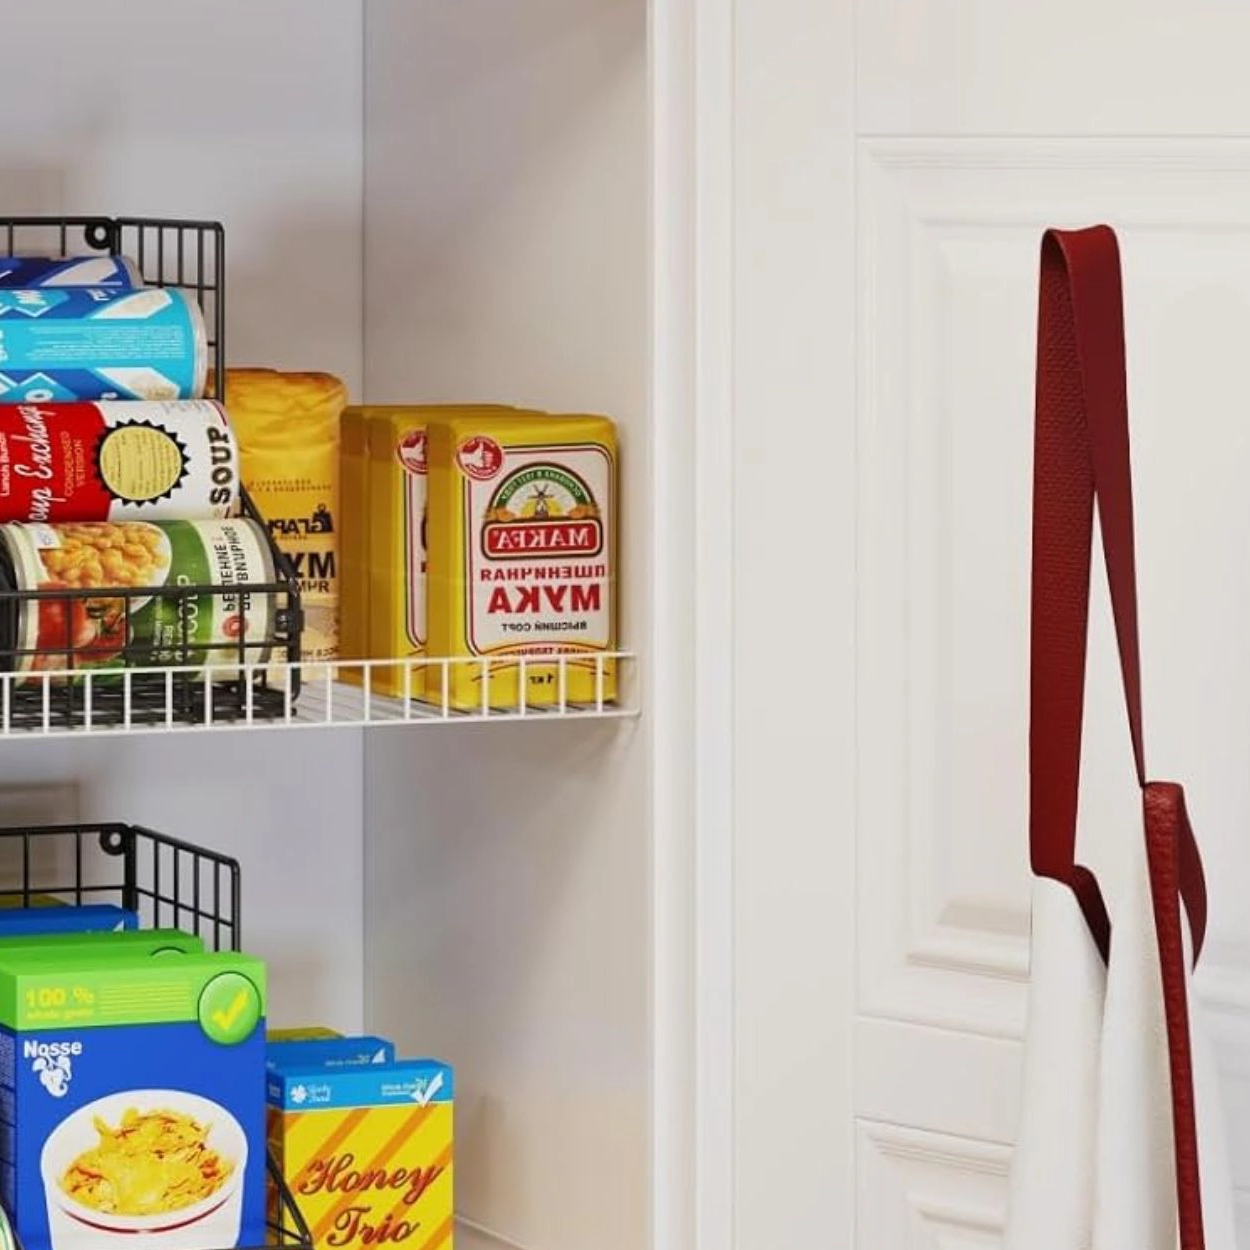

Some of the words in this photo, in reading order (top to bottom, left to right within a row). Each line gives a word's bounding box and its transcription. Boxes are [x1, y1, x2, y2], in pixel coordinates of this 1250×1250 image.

[206, 426, 233, 506] SOUP
[24, 988, 68, 1009] 100
[24, 1040, 83, 1060] Nosse
[299, 1152, 445, 1204] Honey
[326, 1206, 421, 1248] Trio
